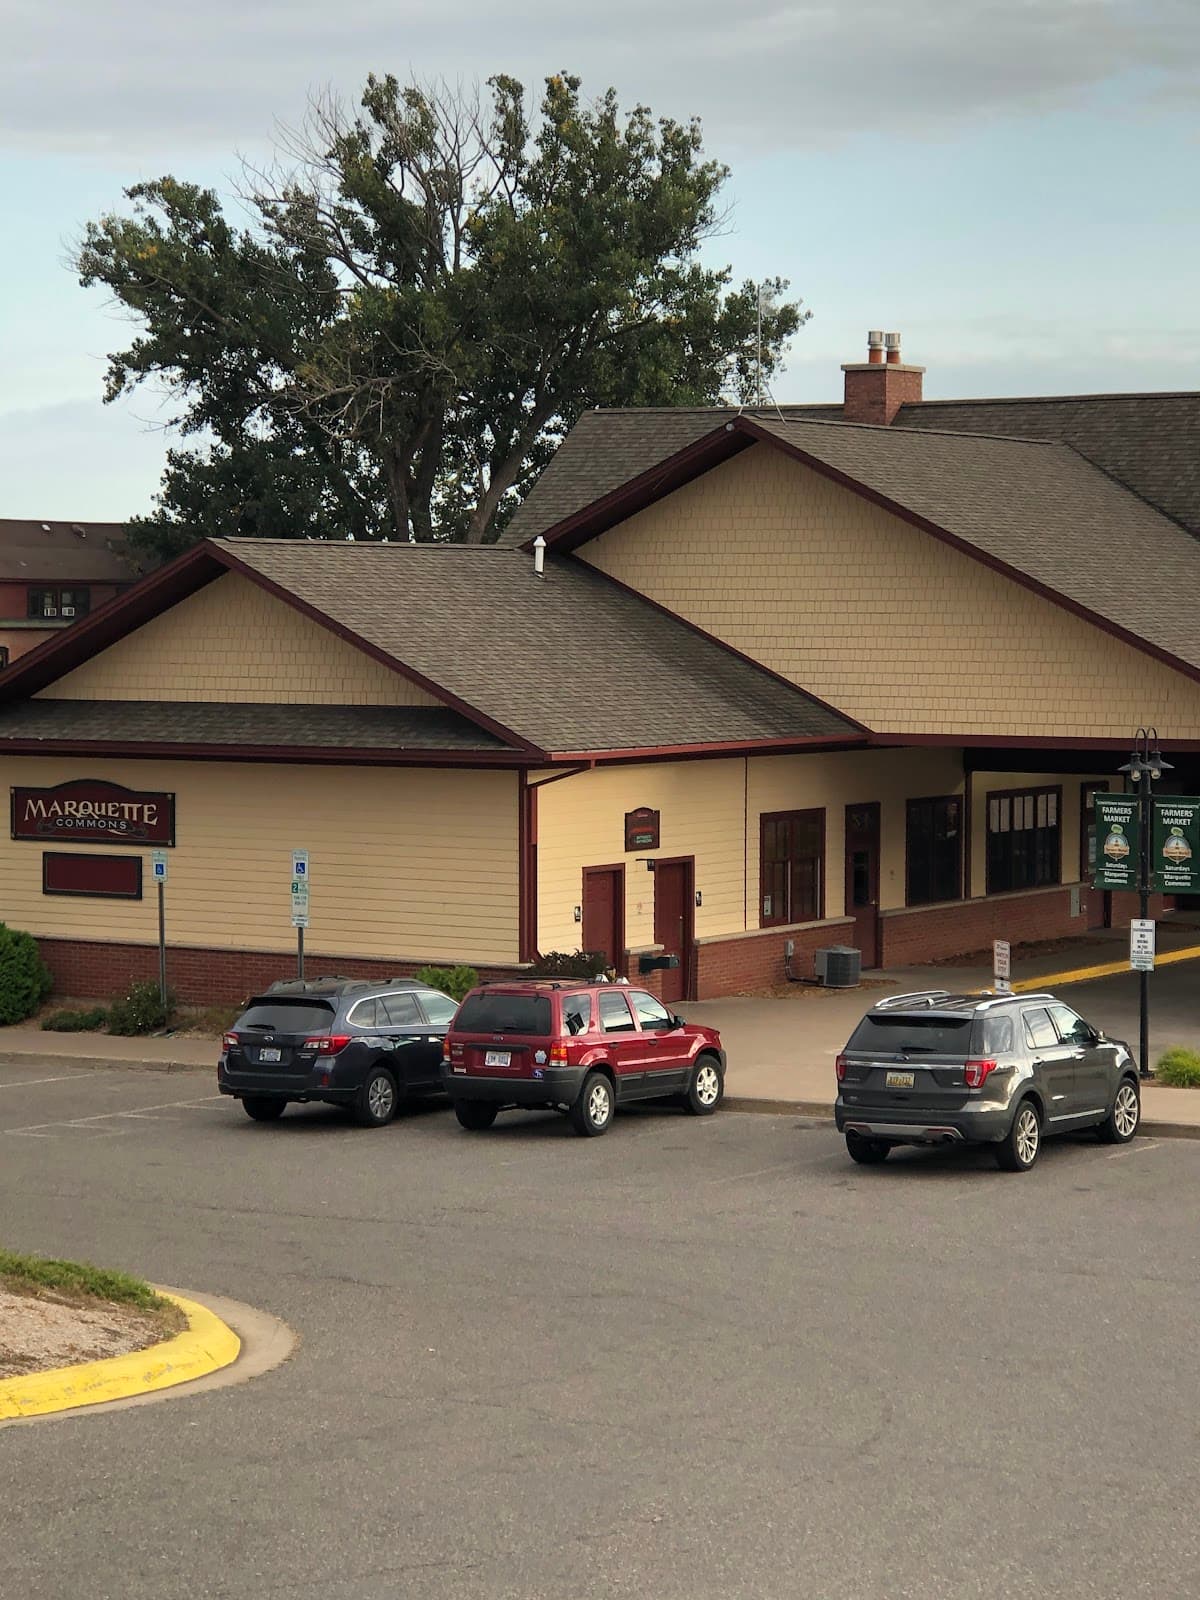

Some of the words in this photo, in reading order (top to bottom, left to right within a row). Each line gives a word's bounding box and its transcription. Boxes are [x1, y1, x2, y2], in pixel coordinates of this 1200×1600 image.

[24, 799, 158, 825] MARQUETTE
[1102, 806, 1132, 815] FARMERS
[1161, 809, 1193, 818] FARMERS
[1103, 815, 1130, 823] MARKET
[1162, 818, 1191, 826] MARKET
[56, 818, 127, 830] COMMONS
